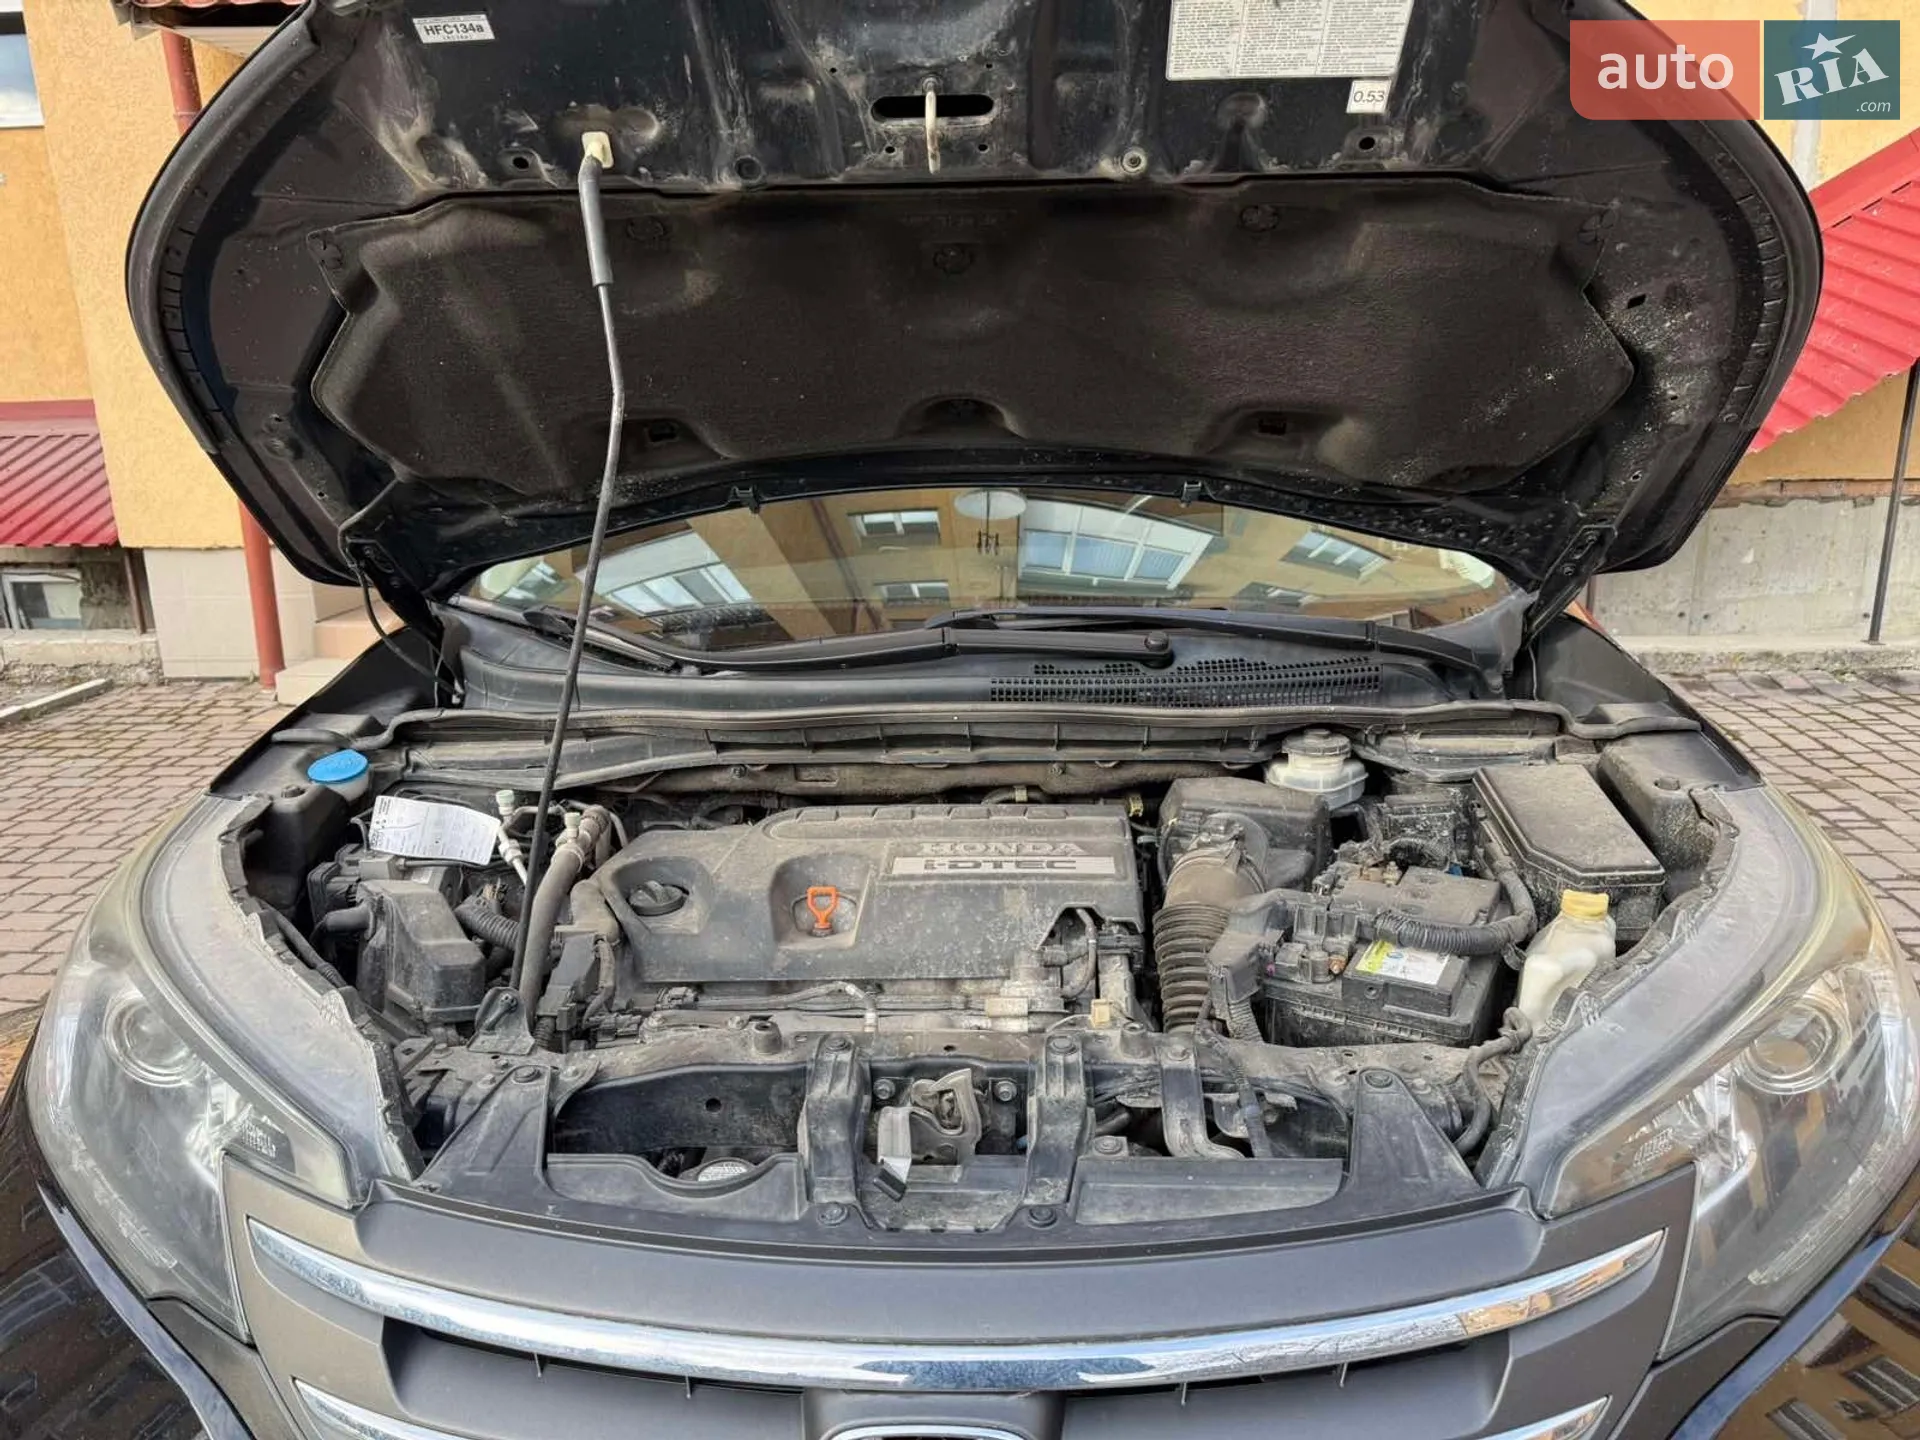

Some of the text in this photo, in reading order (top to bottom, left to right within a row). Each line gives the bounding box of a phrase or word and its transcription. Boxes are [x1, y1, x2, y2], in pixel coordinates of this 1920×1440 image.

[423, 23, 484, 36] HFC134a
[1353, 91, 1385, 103] 0.53
[917, 842, 1090, 857] HONDA
